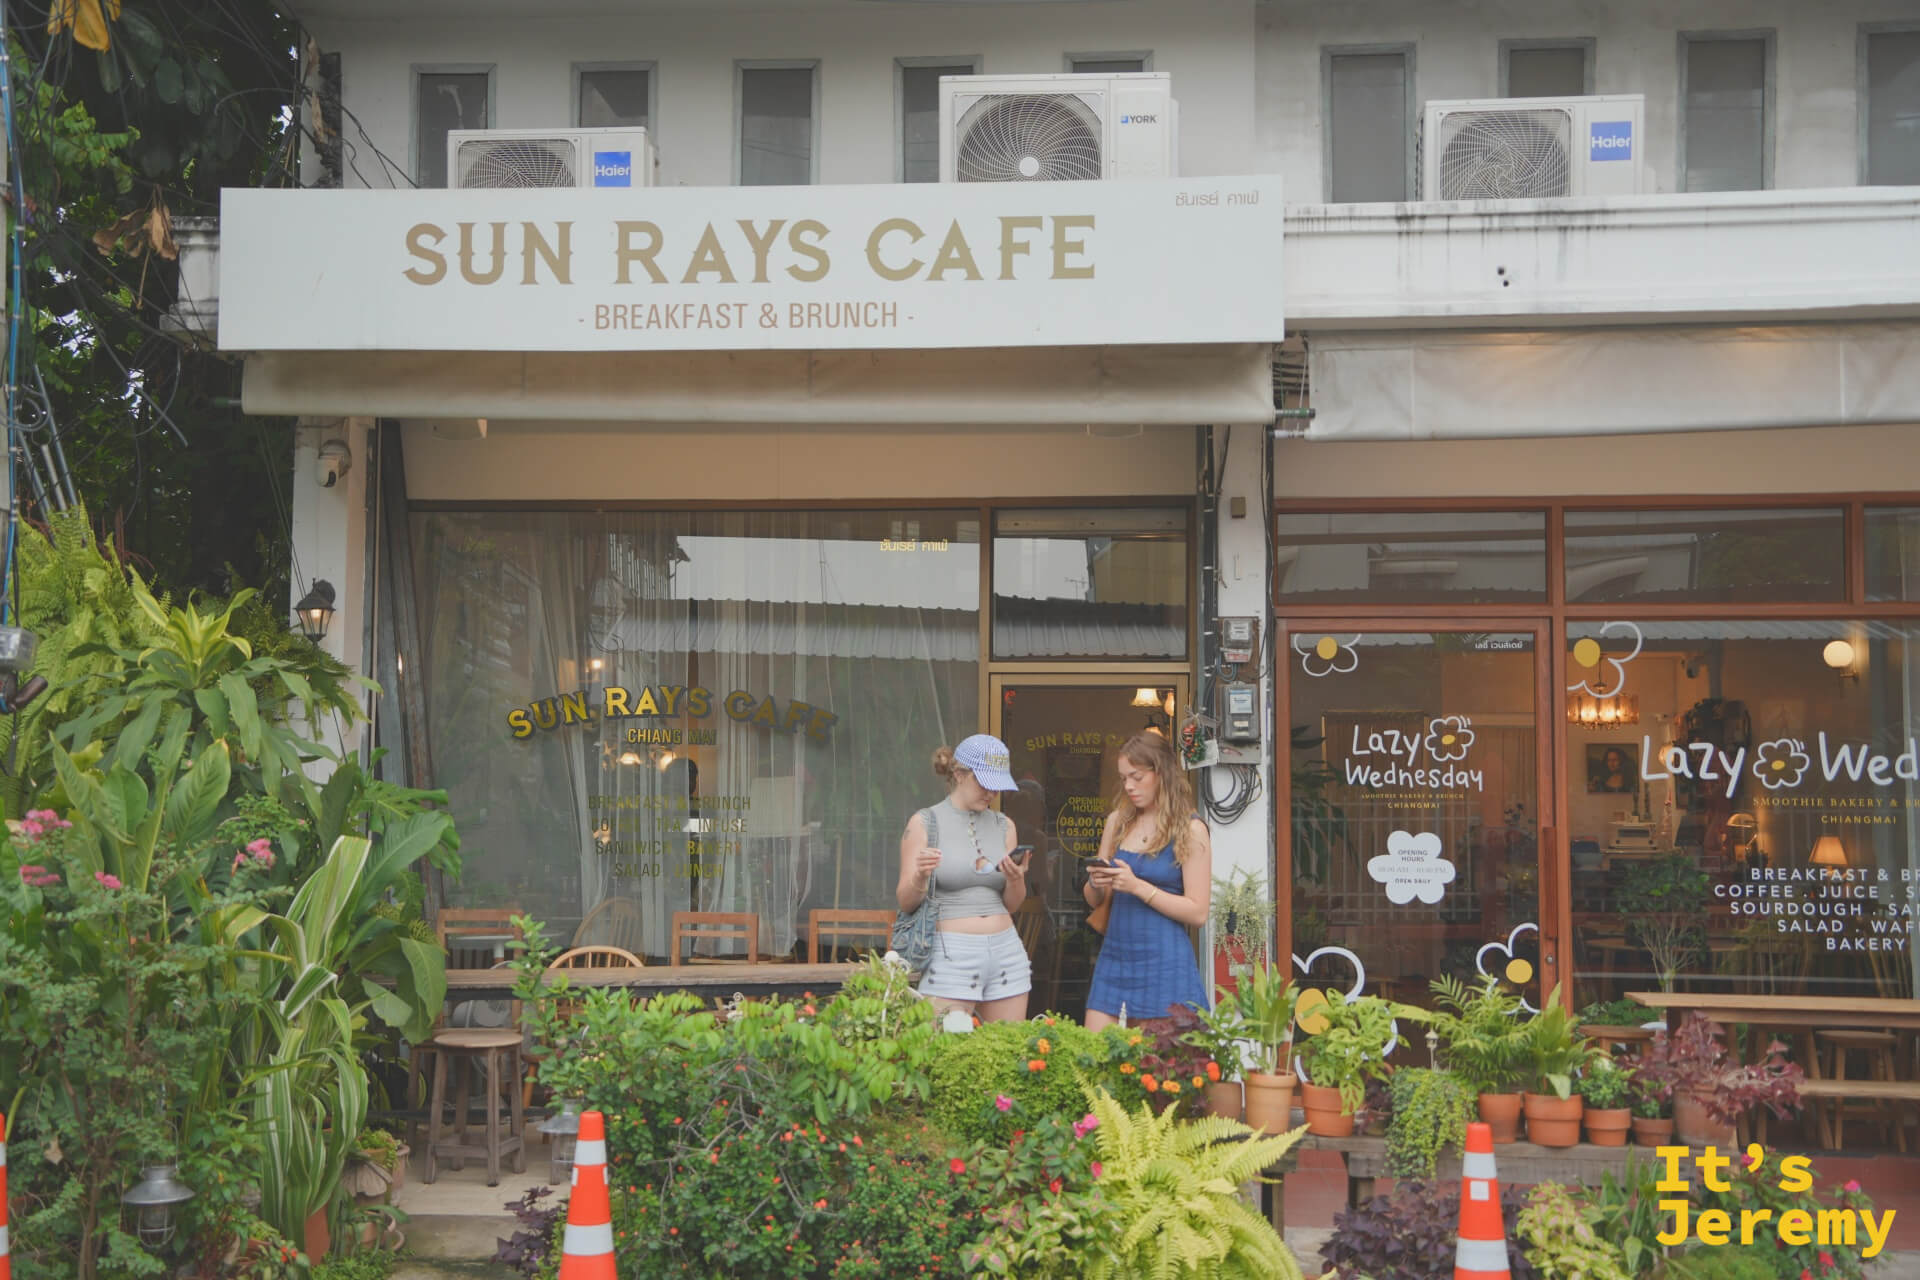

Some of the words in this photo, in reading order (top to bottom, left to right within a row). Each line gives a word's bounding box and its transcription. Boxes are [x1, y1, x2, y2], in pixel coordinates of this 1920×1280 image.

[1130, 115, 1157, 124] YORK
[1591, 135, 1631, 149] Haier
[595, 164, 631, 177] Haier
[402, 221, 576, 286] SUN
[613, 218, 832, 285] RAYS
[864, 215, 1096, 283] CAFE
[594, 303, 748, 330] BREAKFAST
[757, 301, 780, 329] &
[788, 301, 898, 328] BRUNCH
[507, 691, 590, 740] SUN
[603, 685, 713, 719] RAYS
[723, 690, 838, 747] CAFE
[626, 728, 682, 745] CHIANG
[687, 728, 717, 746] MAI
[1026, 733, 1056, 752] SUN
[1063, 731, 1102, 745] RAYS
[1352, 724, 1421, 767] Lazy
[1641, 735, 1746, 798] Lazy
[1818, 731, 1919, 786] Wed
[1345, 758, 1483, 792] Wednesday
[588, 795, 670, 810] BREAKFAST
[692, 796, 751, 810] BRUNCH
[1753, 798, 1824, 808] SMOOTHIE
[1830, 798, 1883, 809] BAKERY
[700, 818, 748, 833] INFUSE
[1060, 816, 1092, 827] 08.00
[1821, 815, 1898, 825] CHIANGMAI
[1066, 828, 1095, 837] 05.00
[596, 840, 672, 855] SANDWICH
[687, 840, 742, 856] BAKERY
[615, 863, 661, 878] SALAD
[675, 863, 723, 879] LUNCH
[1751, 868, 1868, 881] BREAKFAST
[1877, 868, 1889, 881] &
[1714, 884, 1793, 898] COFFEE
[1819, 885, 1879, 899] JUICE
[1730, 902, 1862, 916] SOURDOUGH
[1777, 920, 1844, 933] SALAD
[1826, 937, 1905, 950] BAKERY
